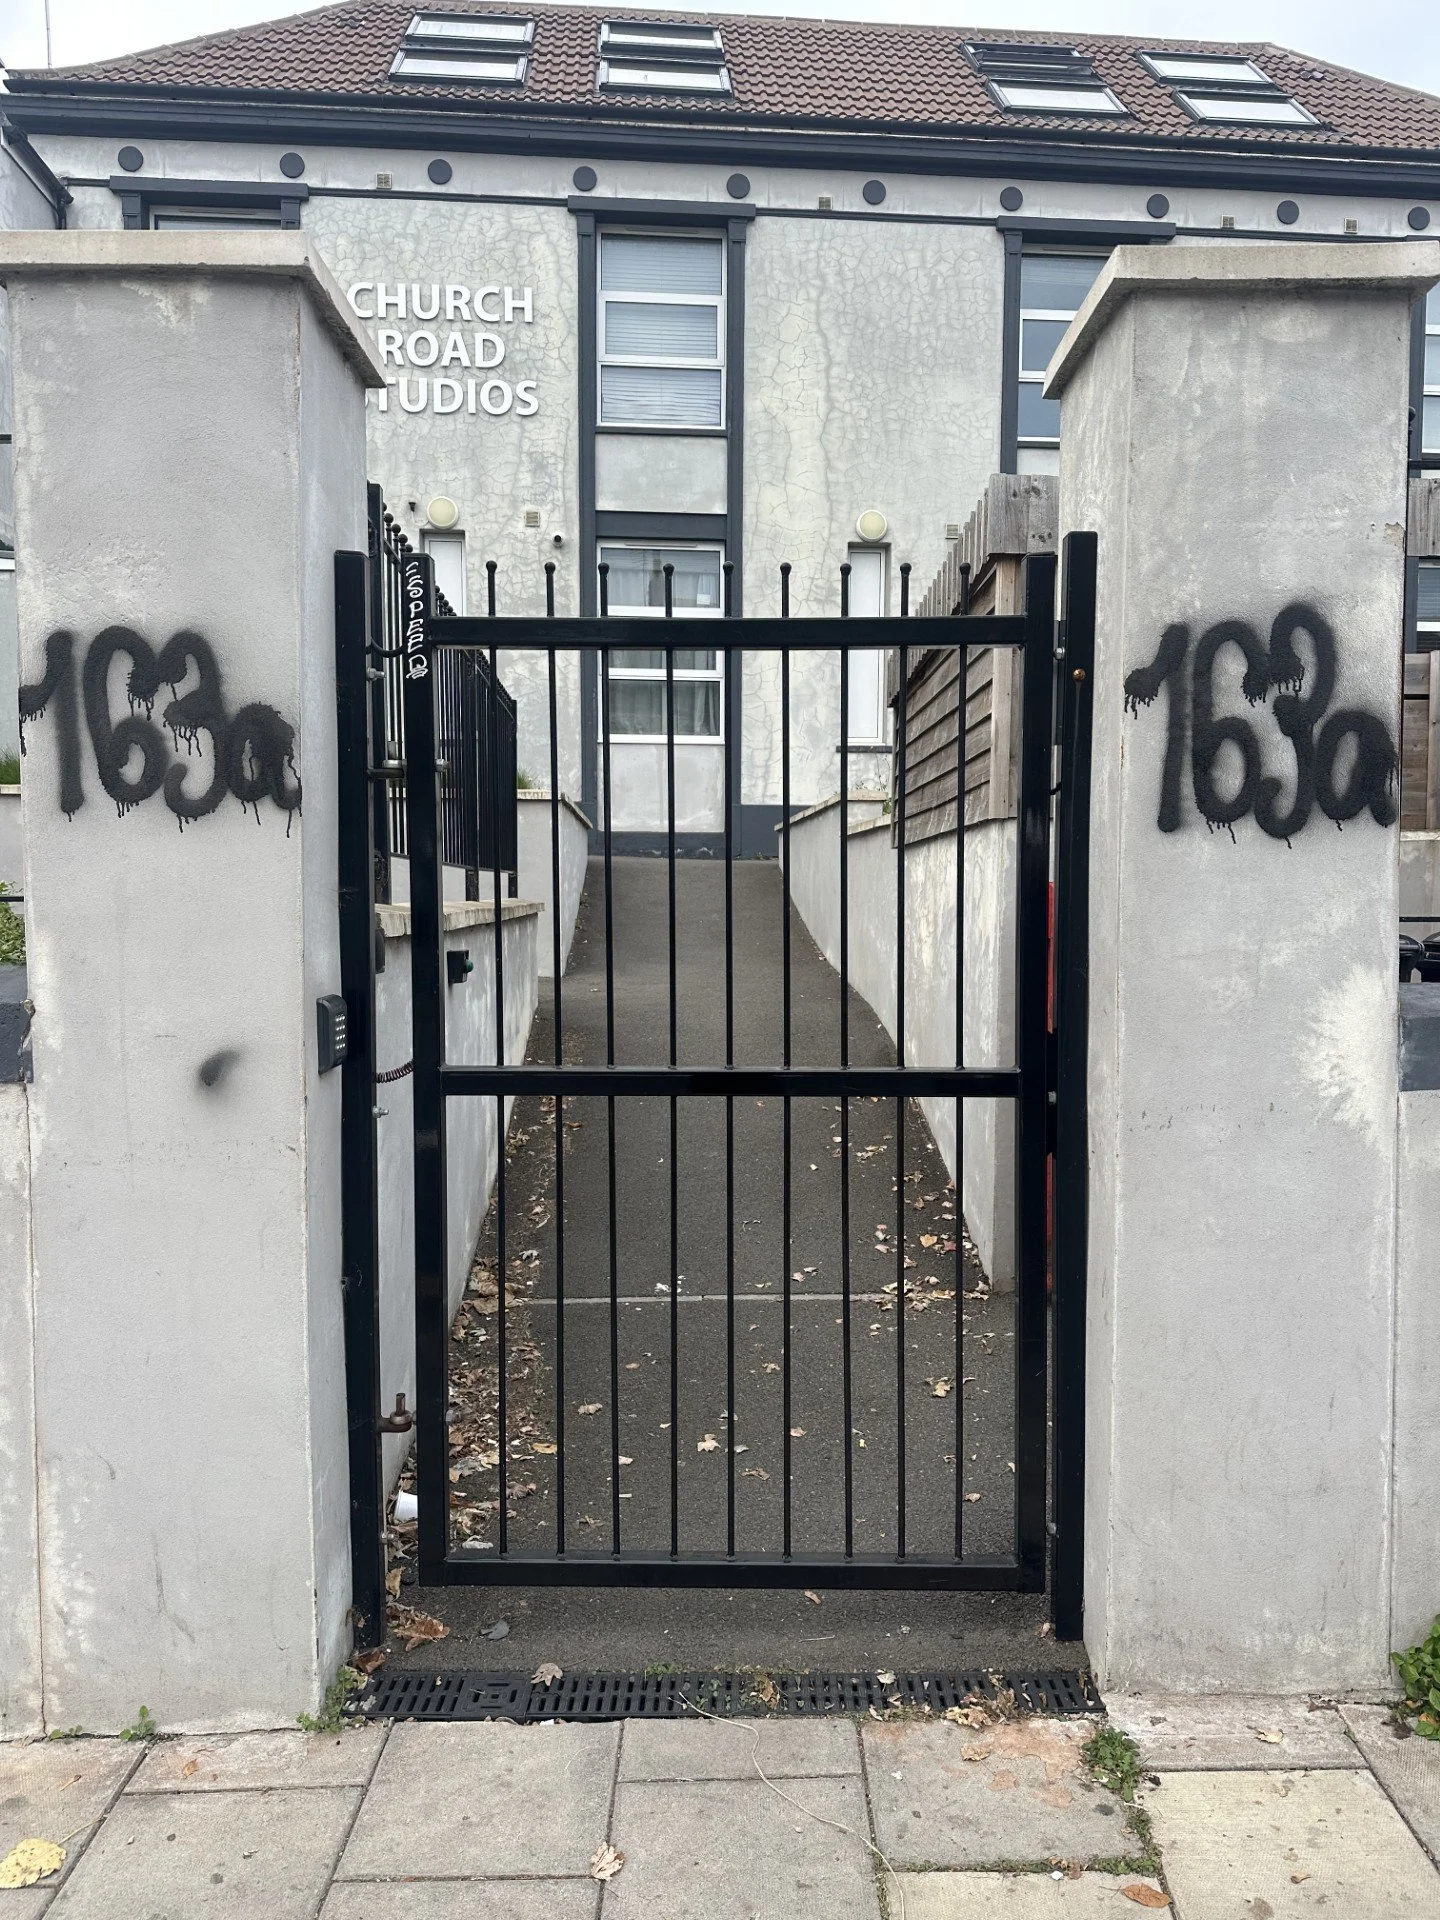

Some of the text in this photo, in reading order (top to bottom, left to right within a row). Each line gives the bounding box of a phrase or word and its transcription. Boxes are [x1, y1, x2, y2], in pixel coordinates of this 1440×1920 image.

[346, 281, 534, 323] CHURCH
[377, 329, 506, 369] ROAD
[365, 376, 540, 416] TUDIOS
